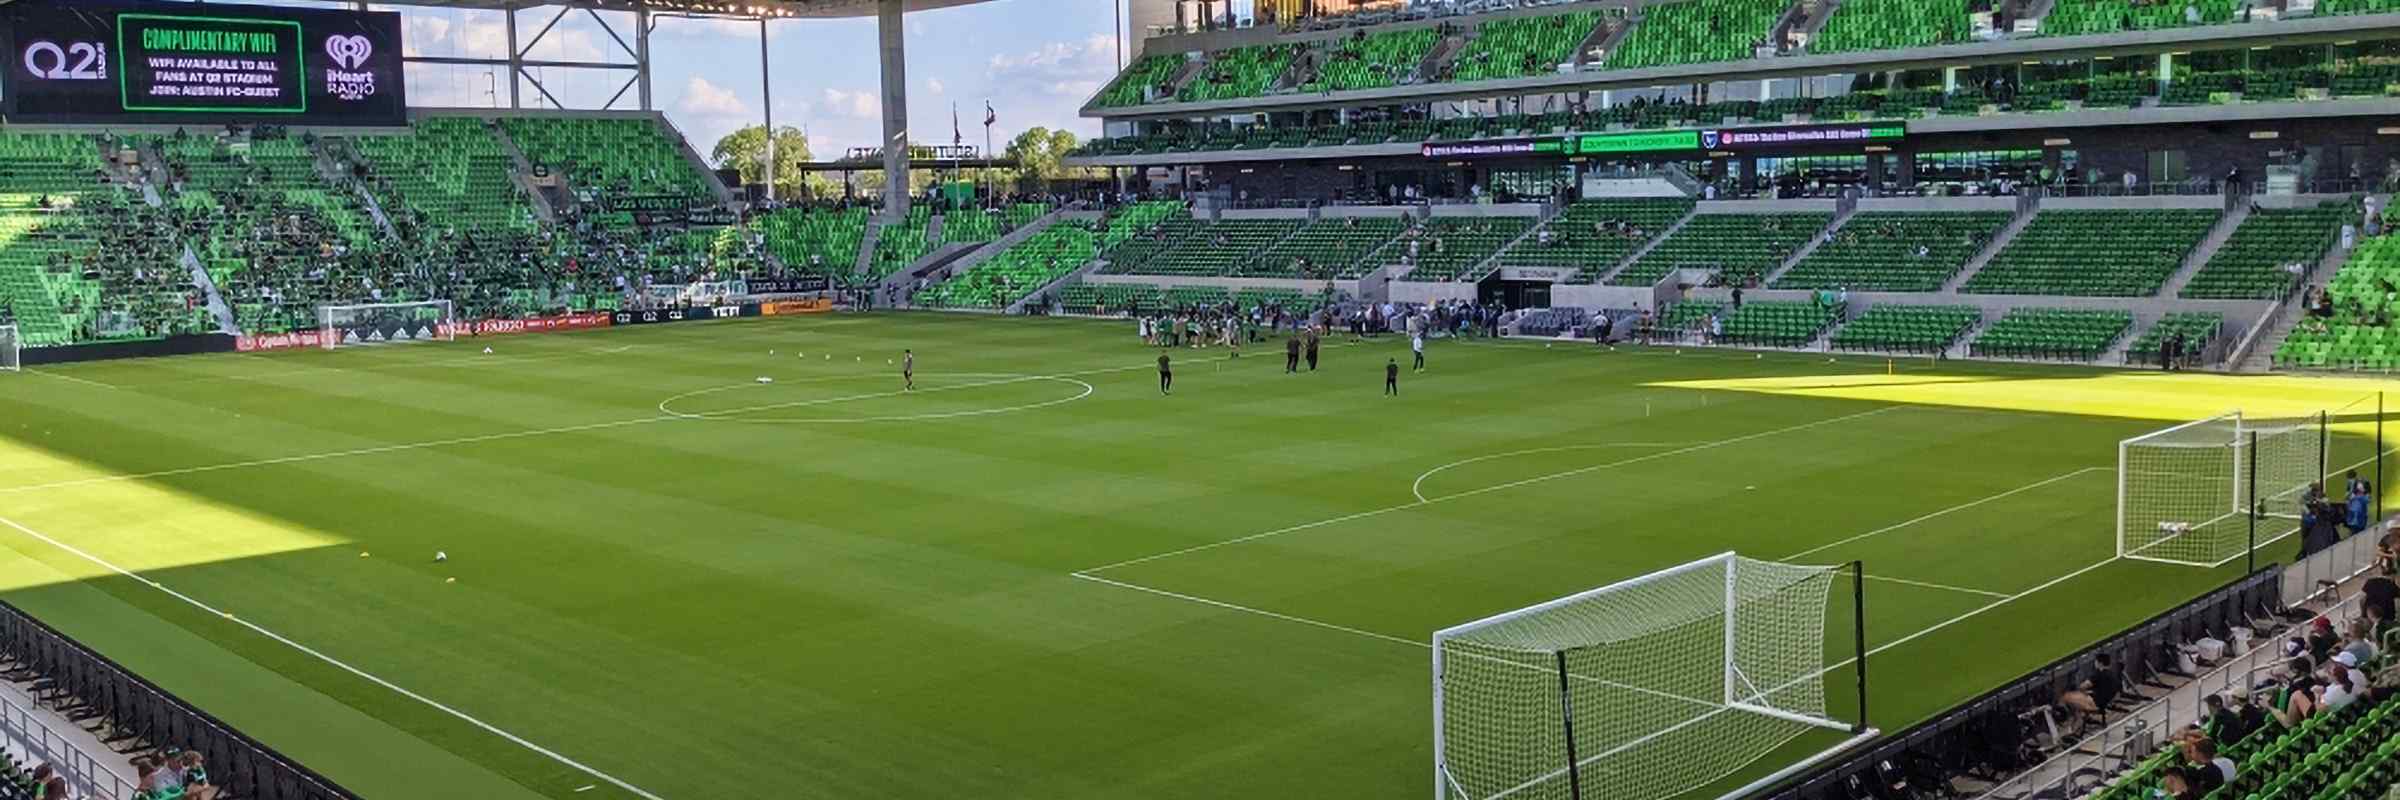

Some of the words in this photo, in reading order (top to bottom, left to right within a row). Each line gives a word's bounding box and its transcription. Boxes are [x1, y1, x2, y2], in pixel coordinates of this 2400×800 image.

[143, 28, 247, 51] COMPLIMENTARY
[249, 33, 277, 53] WIFI
[24, 41, 97, 79] Q2
[148, 57, 175, 68] WIFI
[177, 58, 239, 70] AVAILABLE
[241, 61, 256, 70] TO
[257, 61, 279, 71] ALL
[155, 71, 187, 82] FANS
[189, 72, 204, 82] AT
[223, 73, 273, 84] STADIUM
[327, 69, 373, 82] iHeart
[182, 86, 224, 96] AUSTIN
[327, 83, 375, 95] RADIO
[642, 311, 657, 322] Q2
[711, 305, 740, 317] YETI
